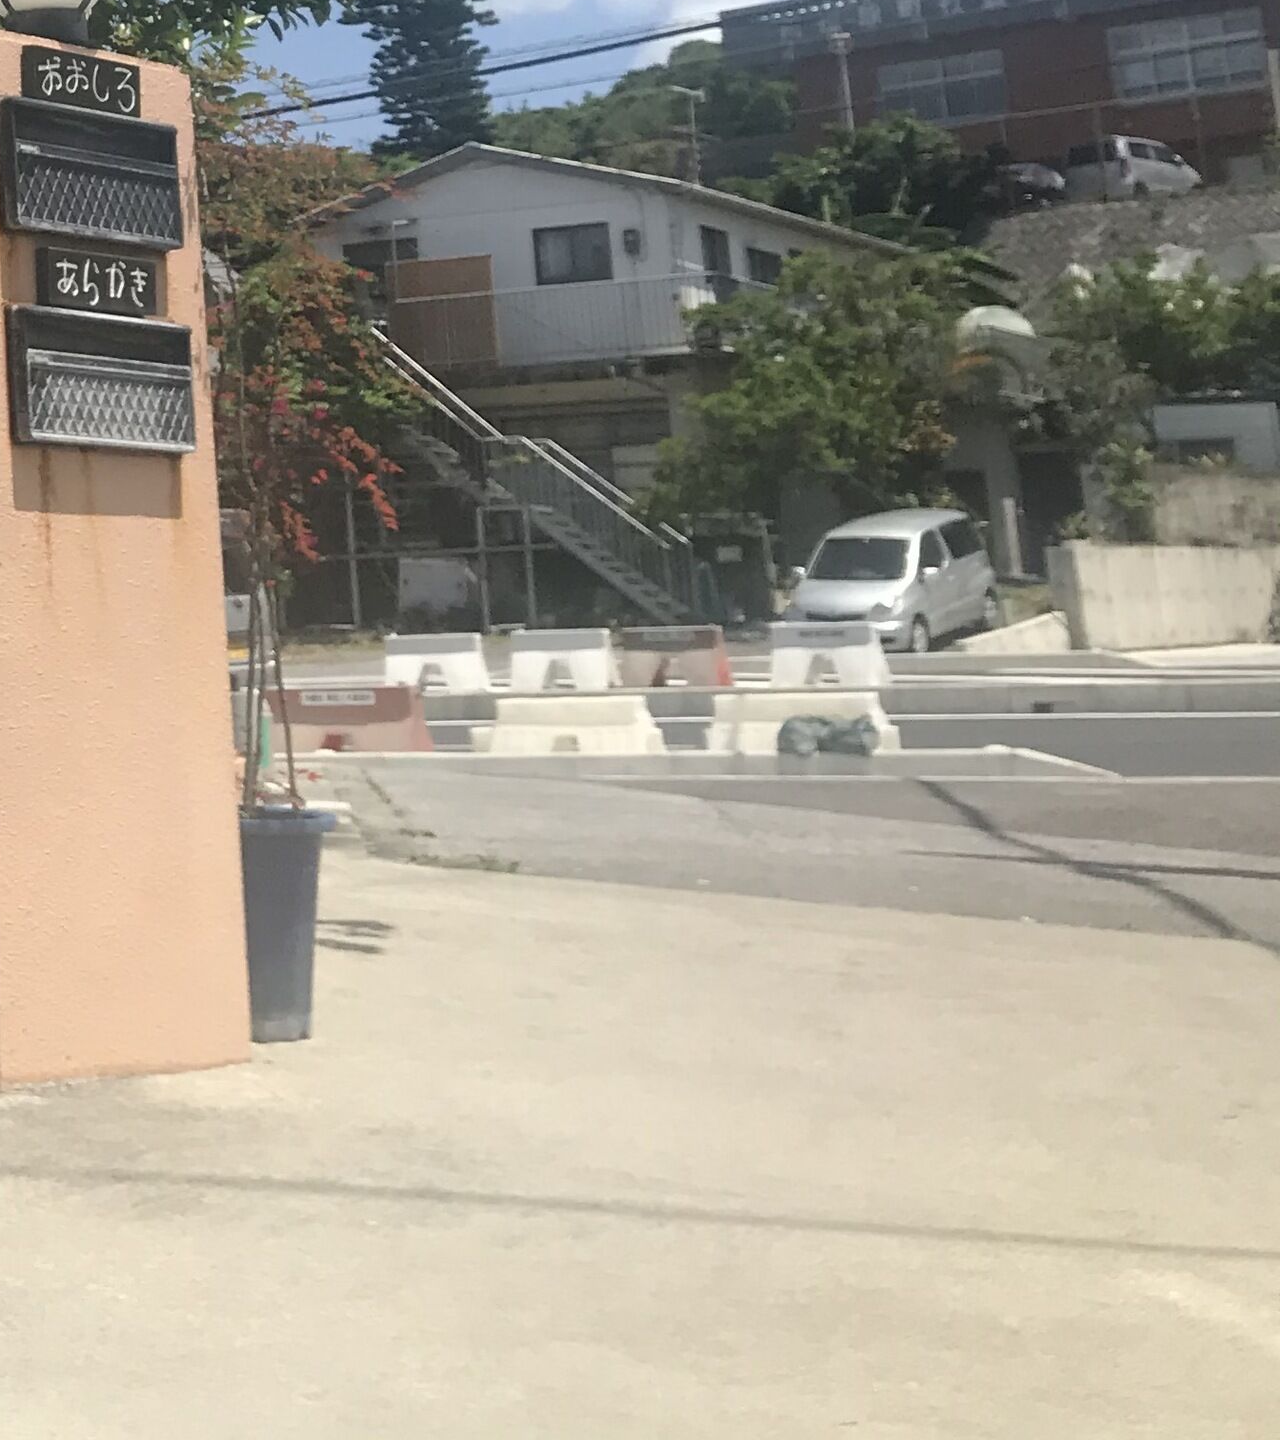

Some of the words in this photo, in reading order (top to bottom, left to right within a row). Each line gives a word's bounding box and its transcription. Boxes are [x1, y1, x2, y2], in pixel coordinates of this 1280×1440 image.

[38, 56, 136, 113] おおしろ
[55, 258, 148, 307] あらかき
